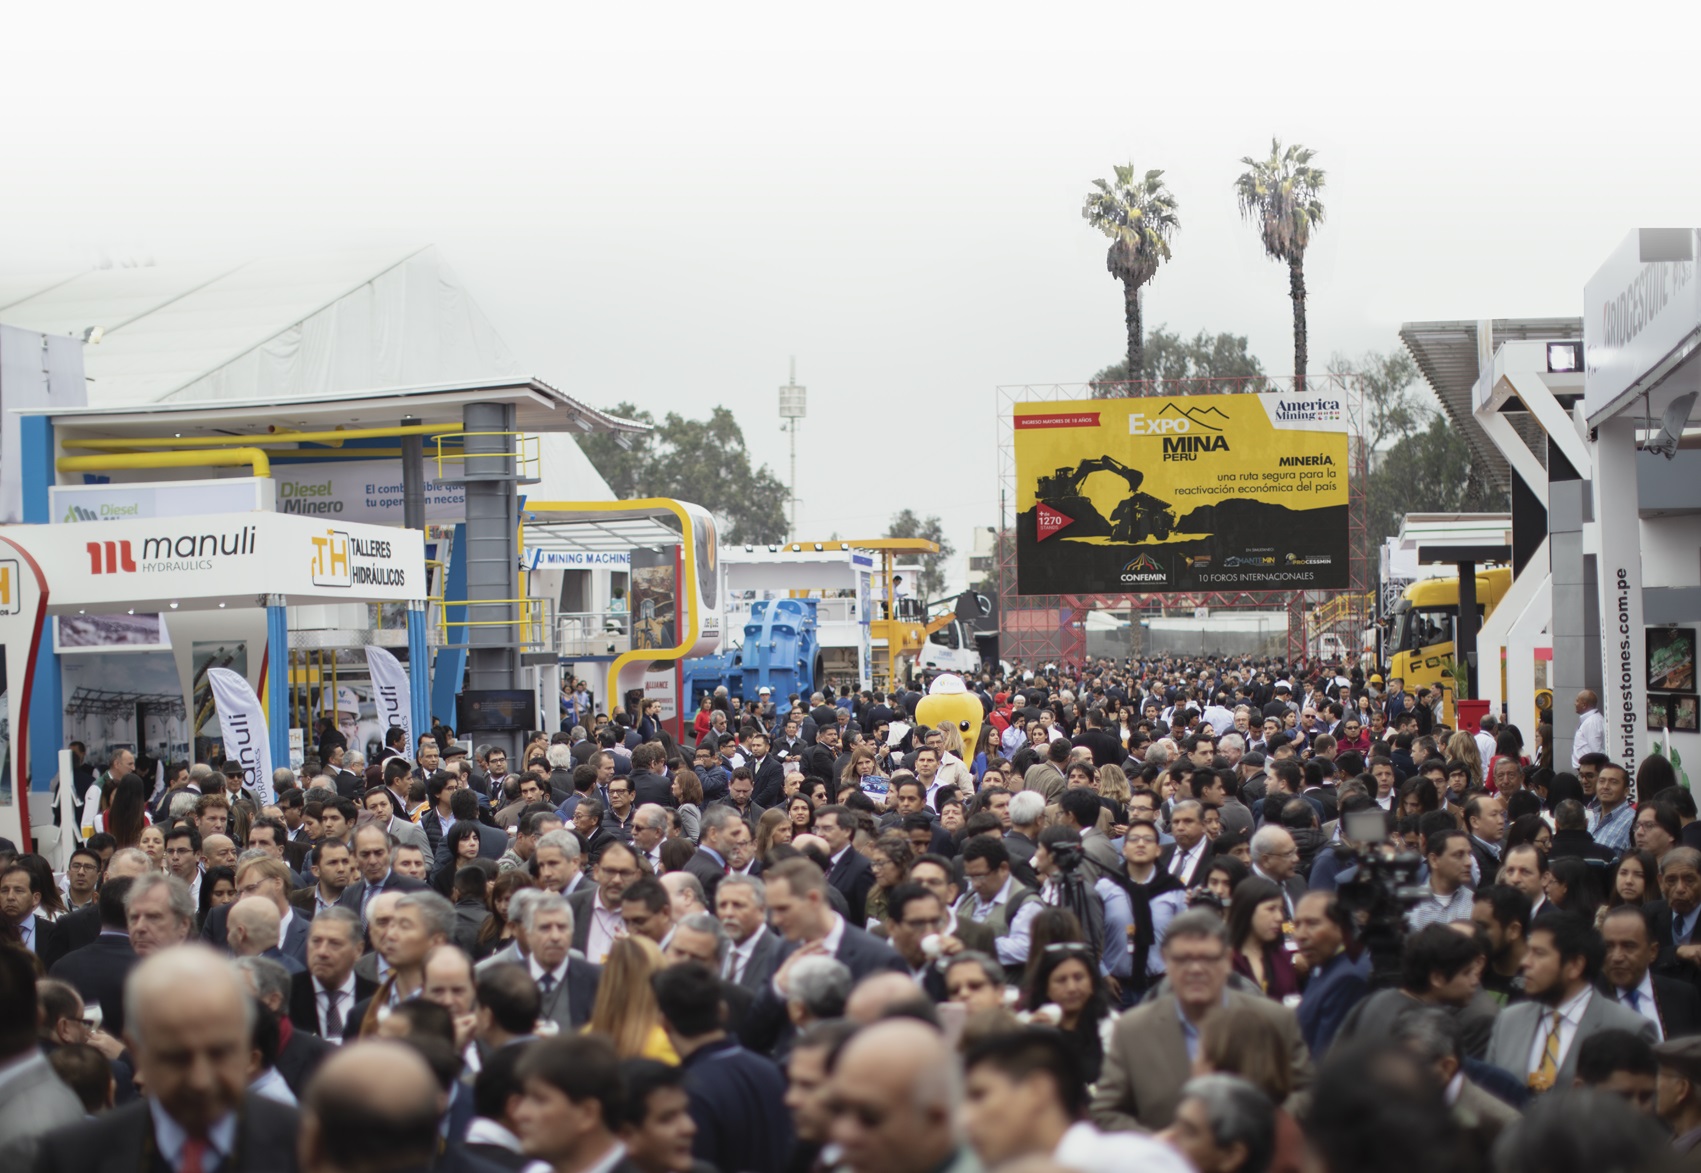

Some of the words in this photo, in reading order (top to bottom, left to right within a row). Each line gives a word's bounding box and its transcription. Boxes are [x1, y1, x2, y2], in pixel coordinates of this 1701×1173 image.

[1276, 398, 1340, 412] America
[1275, 411, 1316, 421] Mining
[1163, 435, 1230, 453] MINA
[1278, 453, 1336, 467] MINERÍA,
[1217, 473, 1236, 482] una
[1239, 472, 1258, 481] ruta
[1262, 472, 1296, 482] segura
[1299, 470, 1323, 481] para
[1326, 468, 1337, 478] la
[280, 480, 333, 498] Diesel
[365, 483, 375, 494] El
[1174, 484, 1235, 496] reactivación
[1237, 482, 1293, 494] económica
[1296, 481, 1312, 492] del
[1315, 481, 1337, 493] país
[284, 499, 344, 514] Minero
[366, 498, 377, 507] tu
[434, 495, 465, 504] neces
[100, 503, 139, 516] Diesel
[1039, 516, 1062, 525] 1270
[142, 525, 256, 560] manuli
[350, 538, 391, 559] TALLERES
[547, 553, 583, 564] MINING
[142, 560, 213, 573] HYDRAULICS
[352, 562, 405, 586] HIDRÁULICOS
[1120, 573, 1167, 582] CONFEMIN
[1199, 574, 1209, 582] 10
[1210, 573, 1238, 582] FOROS
[1240, 572, 1315, 581] INTERNACIONALES
[1410, 652, 1454, 673] FOT
[645, 680, 668, 691] ALLIANCE
[1617, 568, 1637, 807] w.otr.bridgestones.com.pe
[380, 685, 401, 728] nuli
[228, 713, 256, 787] anuli
[254, 747, 268, 806] YDRAULICS
